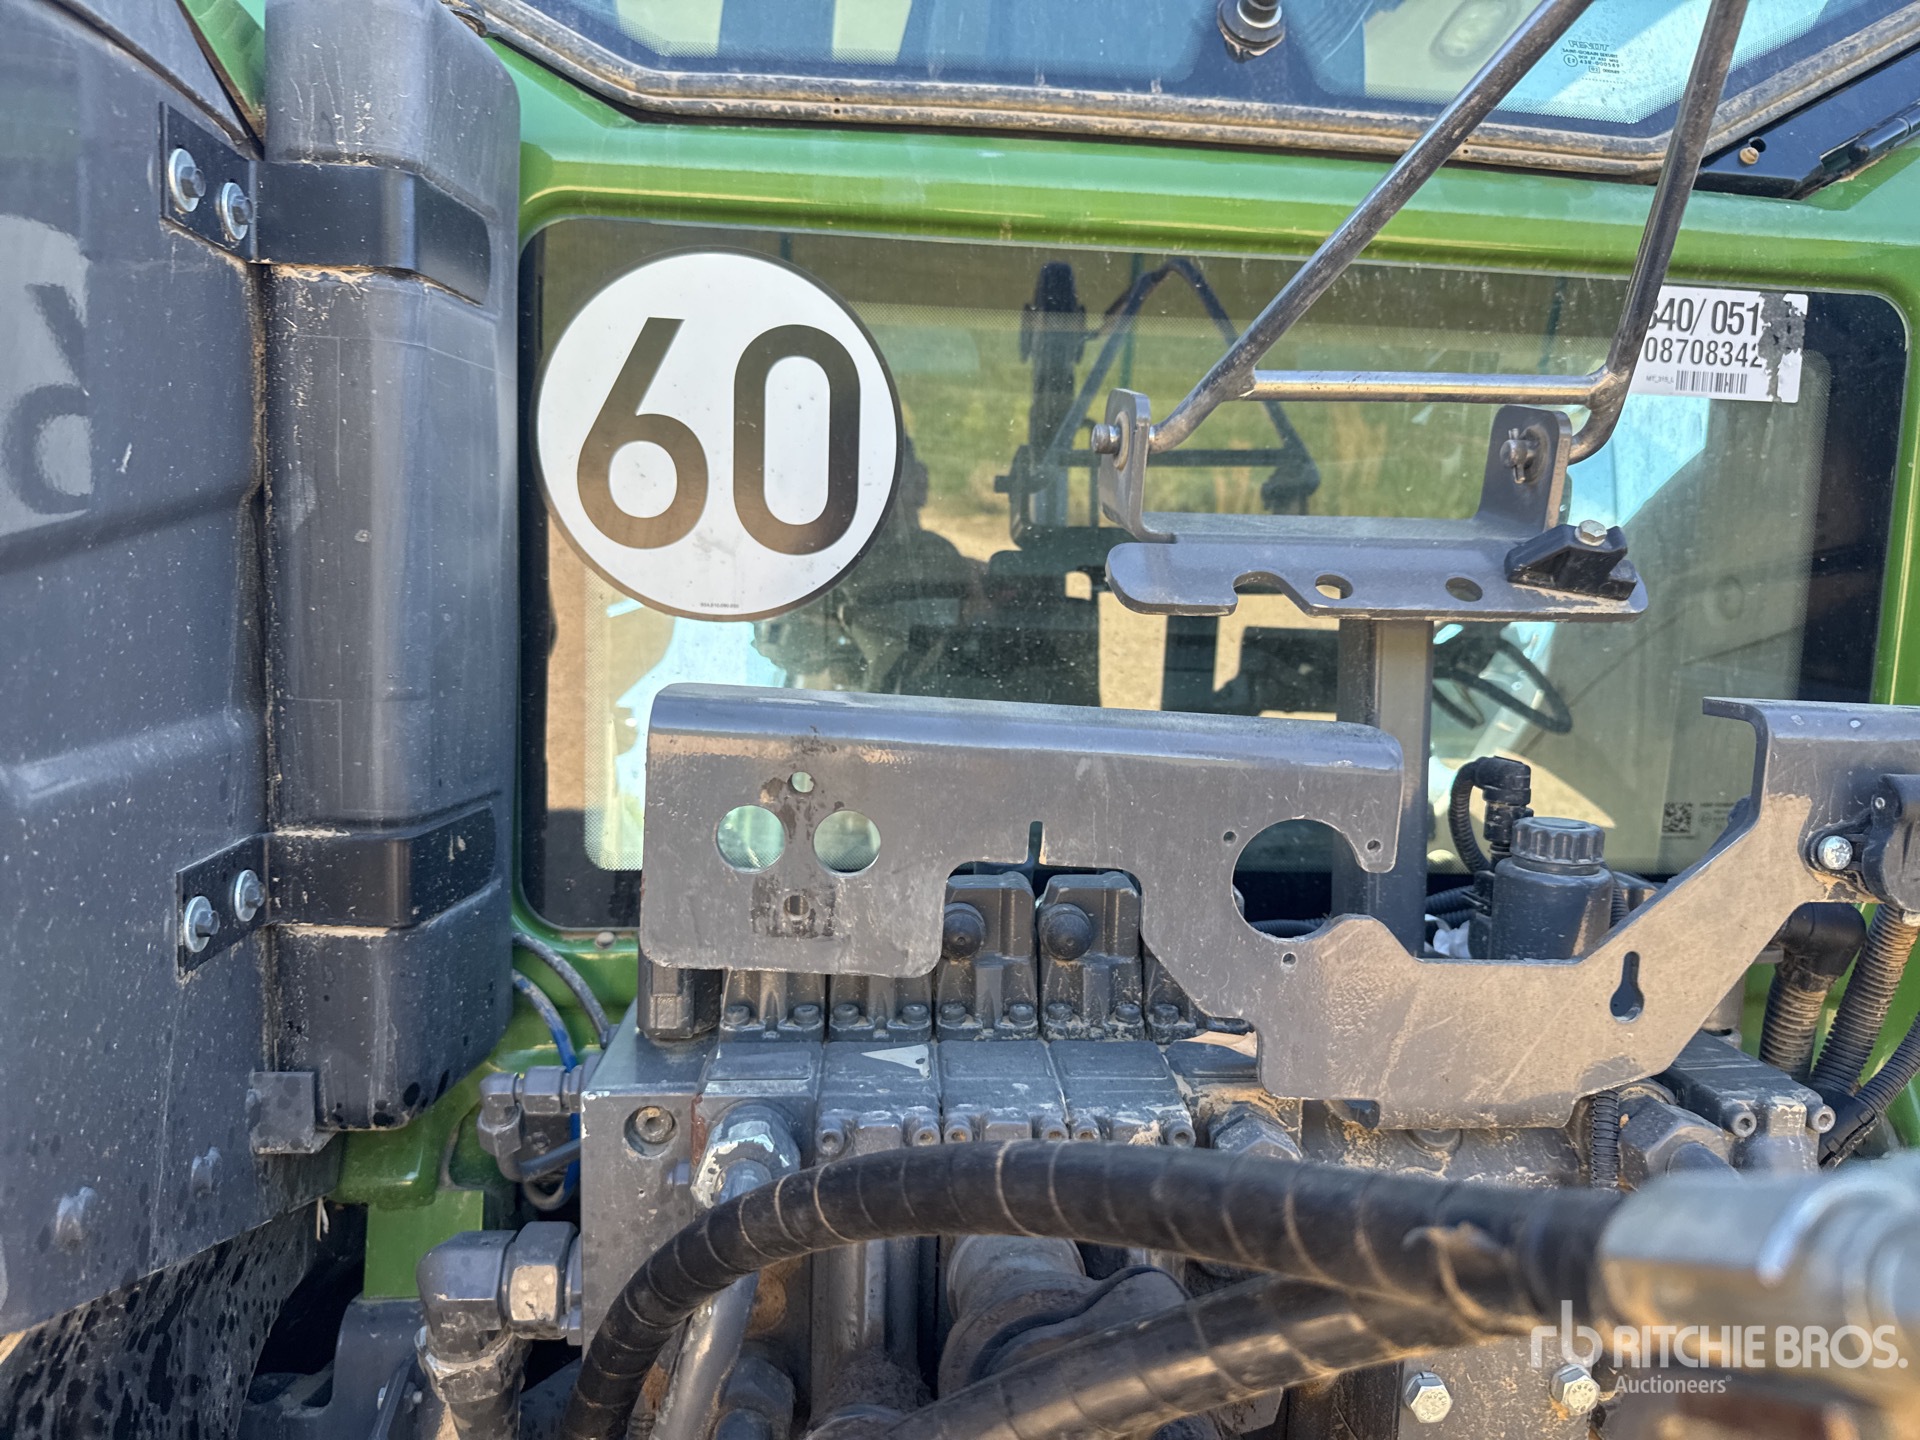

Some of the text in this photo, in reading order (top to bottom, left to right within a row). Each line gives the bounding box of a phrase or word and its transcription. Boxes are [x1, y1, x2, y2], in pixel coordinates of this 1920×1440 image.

[1568, 40, 1609, 51] FENDT
[1645, 337, 1763, 368] 08708342
[577, 317, 860, 555] 60
